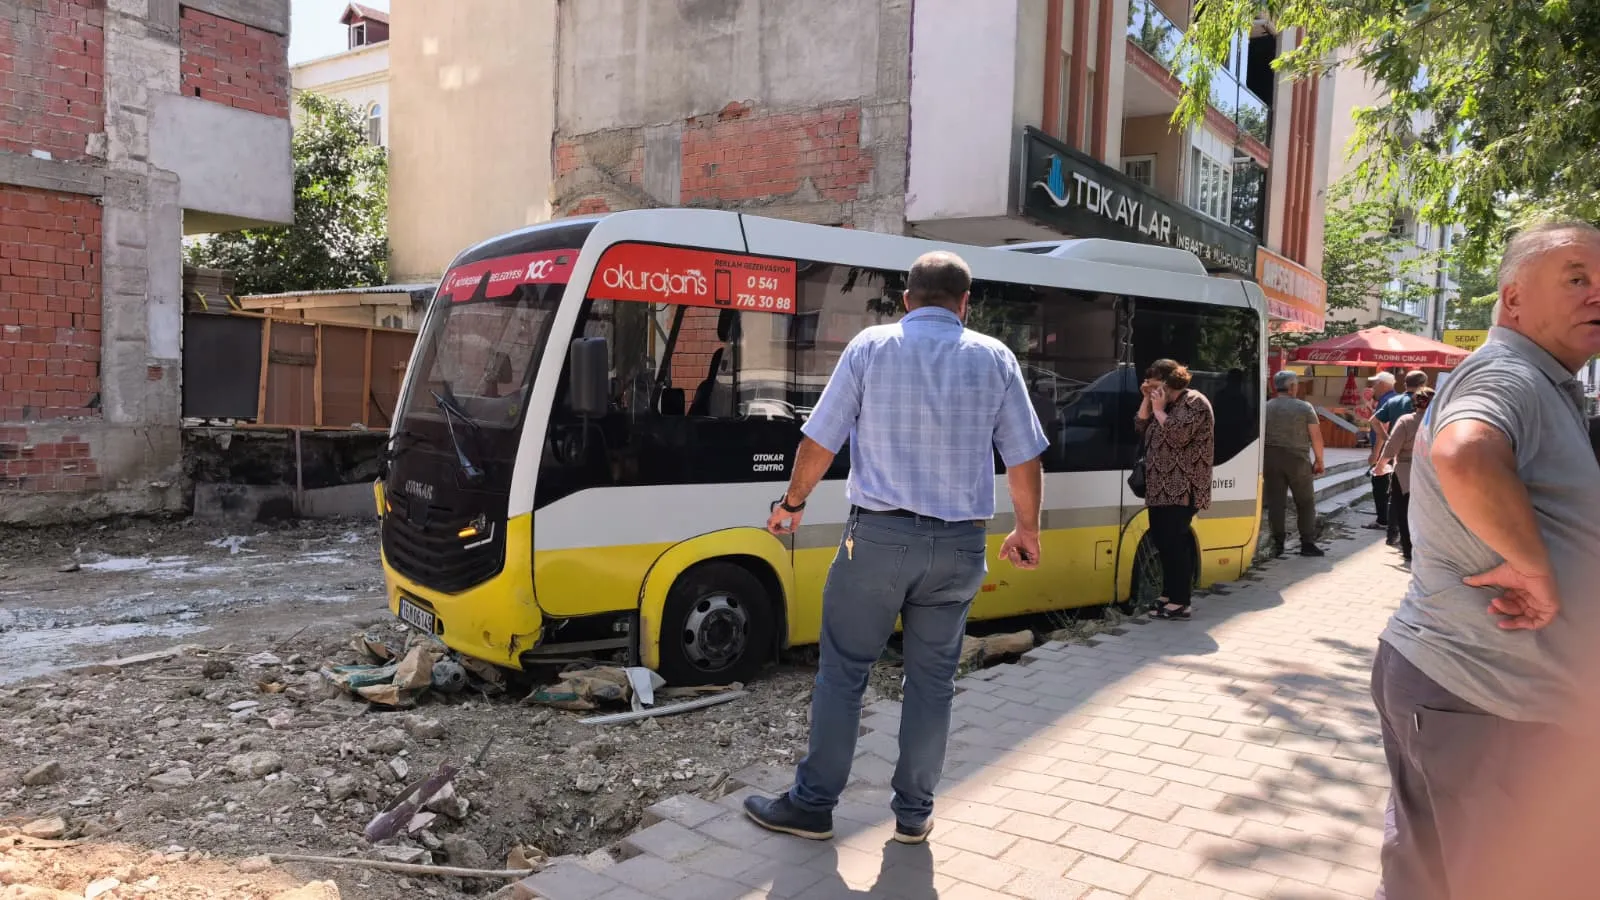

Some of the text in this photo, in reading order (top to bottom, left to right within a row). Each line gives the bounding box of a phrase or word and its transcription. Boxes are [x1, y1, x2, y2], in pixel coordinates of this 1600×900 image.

[1073, 171, 1171, 244] TOKAYLAR
[715, 259, 742, 268] REKLAM
[603, 263, 708, 297] okurajans
[747, 276, 778, 290] 0 541
[736, 294, 791, 310] 776 30 88
[1455, 335, 1480, 343] SEDAT
[753, 453, 784, 462] OTOKAR
[753, 463, 784, 472] CENTRO
[1212, 476, 1236, 489] DİYESİ
[405, 479, 433, 500] OTOKAR
